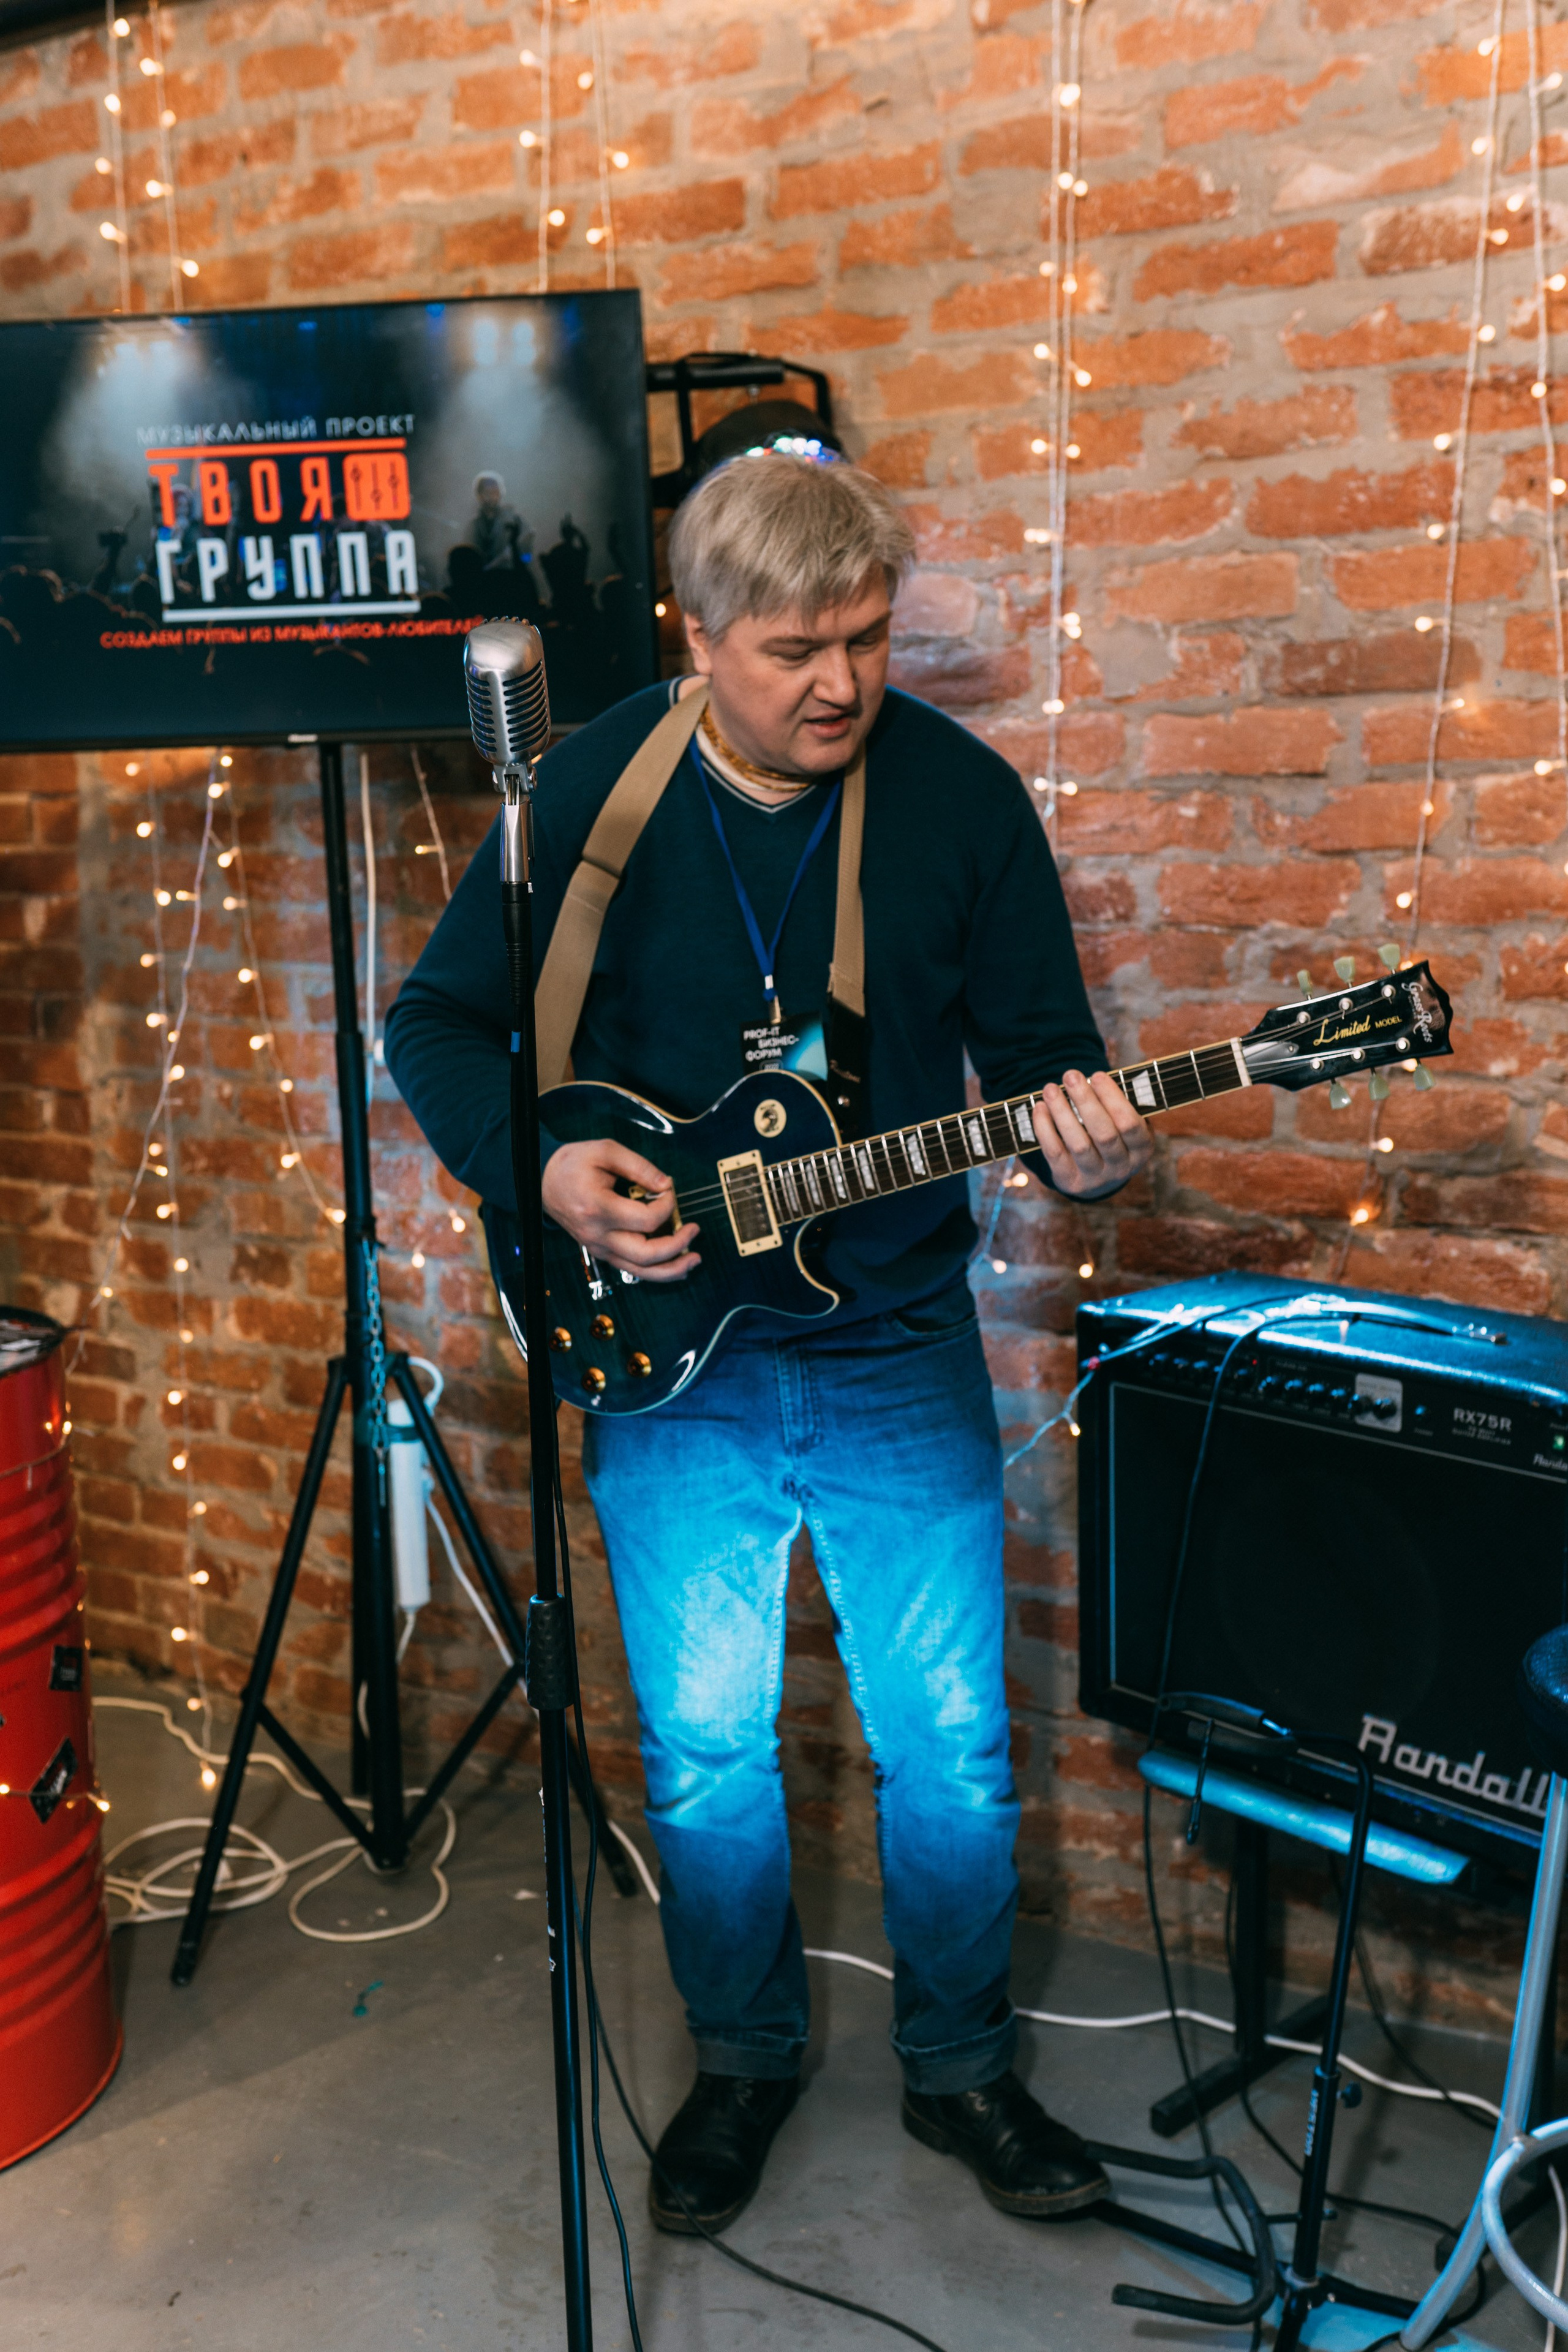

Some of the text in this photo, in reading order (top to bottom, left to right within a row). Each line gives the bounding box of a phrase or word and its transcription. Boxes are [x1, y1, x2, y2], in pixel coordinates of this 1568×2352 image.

[137, 414, 415, 445] МУЗЫКАЛЬНЫЙ ПРОЕКТ
[149, 458, 333, 527] ТВОЯ
[156, 530, 418, 603] ГРУППА
[100, 630, 183, 649] СОЗДАЕМ
[185, 626, 247, 645] ГРУППЫ
[249, 625, 273, 643] ИЗ
[744, 1027, 780, 1040] PROF-IT
[1314, 1015, 1401, 1046] Limited MODEL
[745, 1048, 782, 1061] ФОРУМ
[1452, 1407, 1513, 1433] RX75R
[1358, 1714, 1549, 1818] Randall
